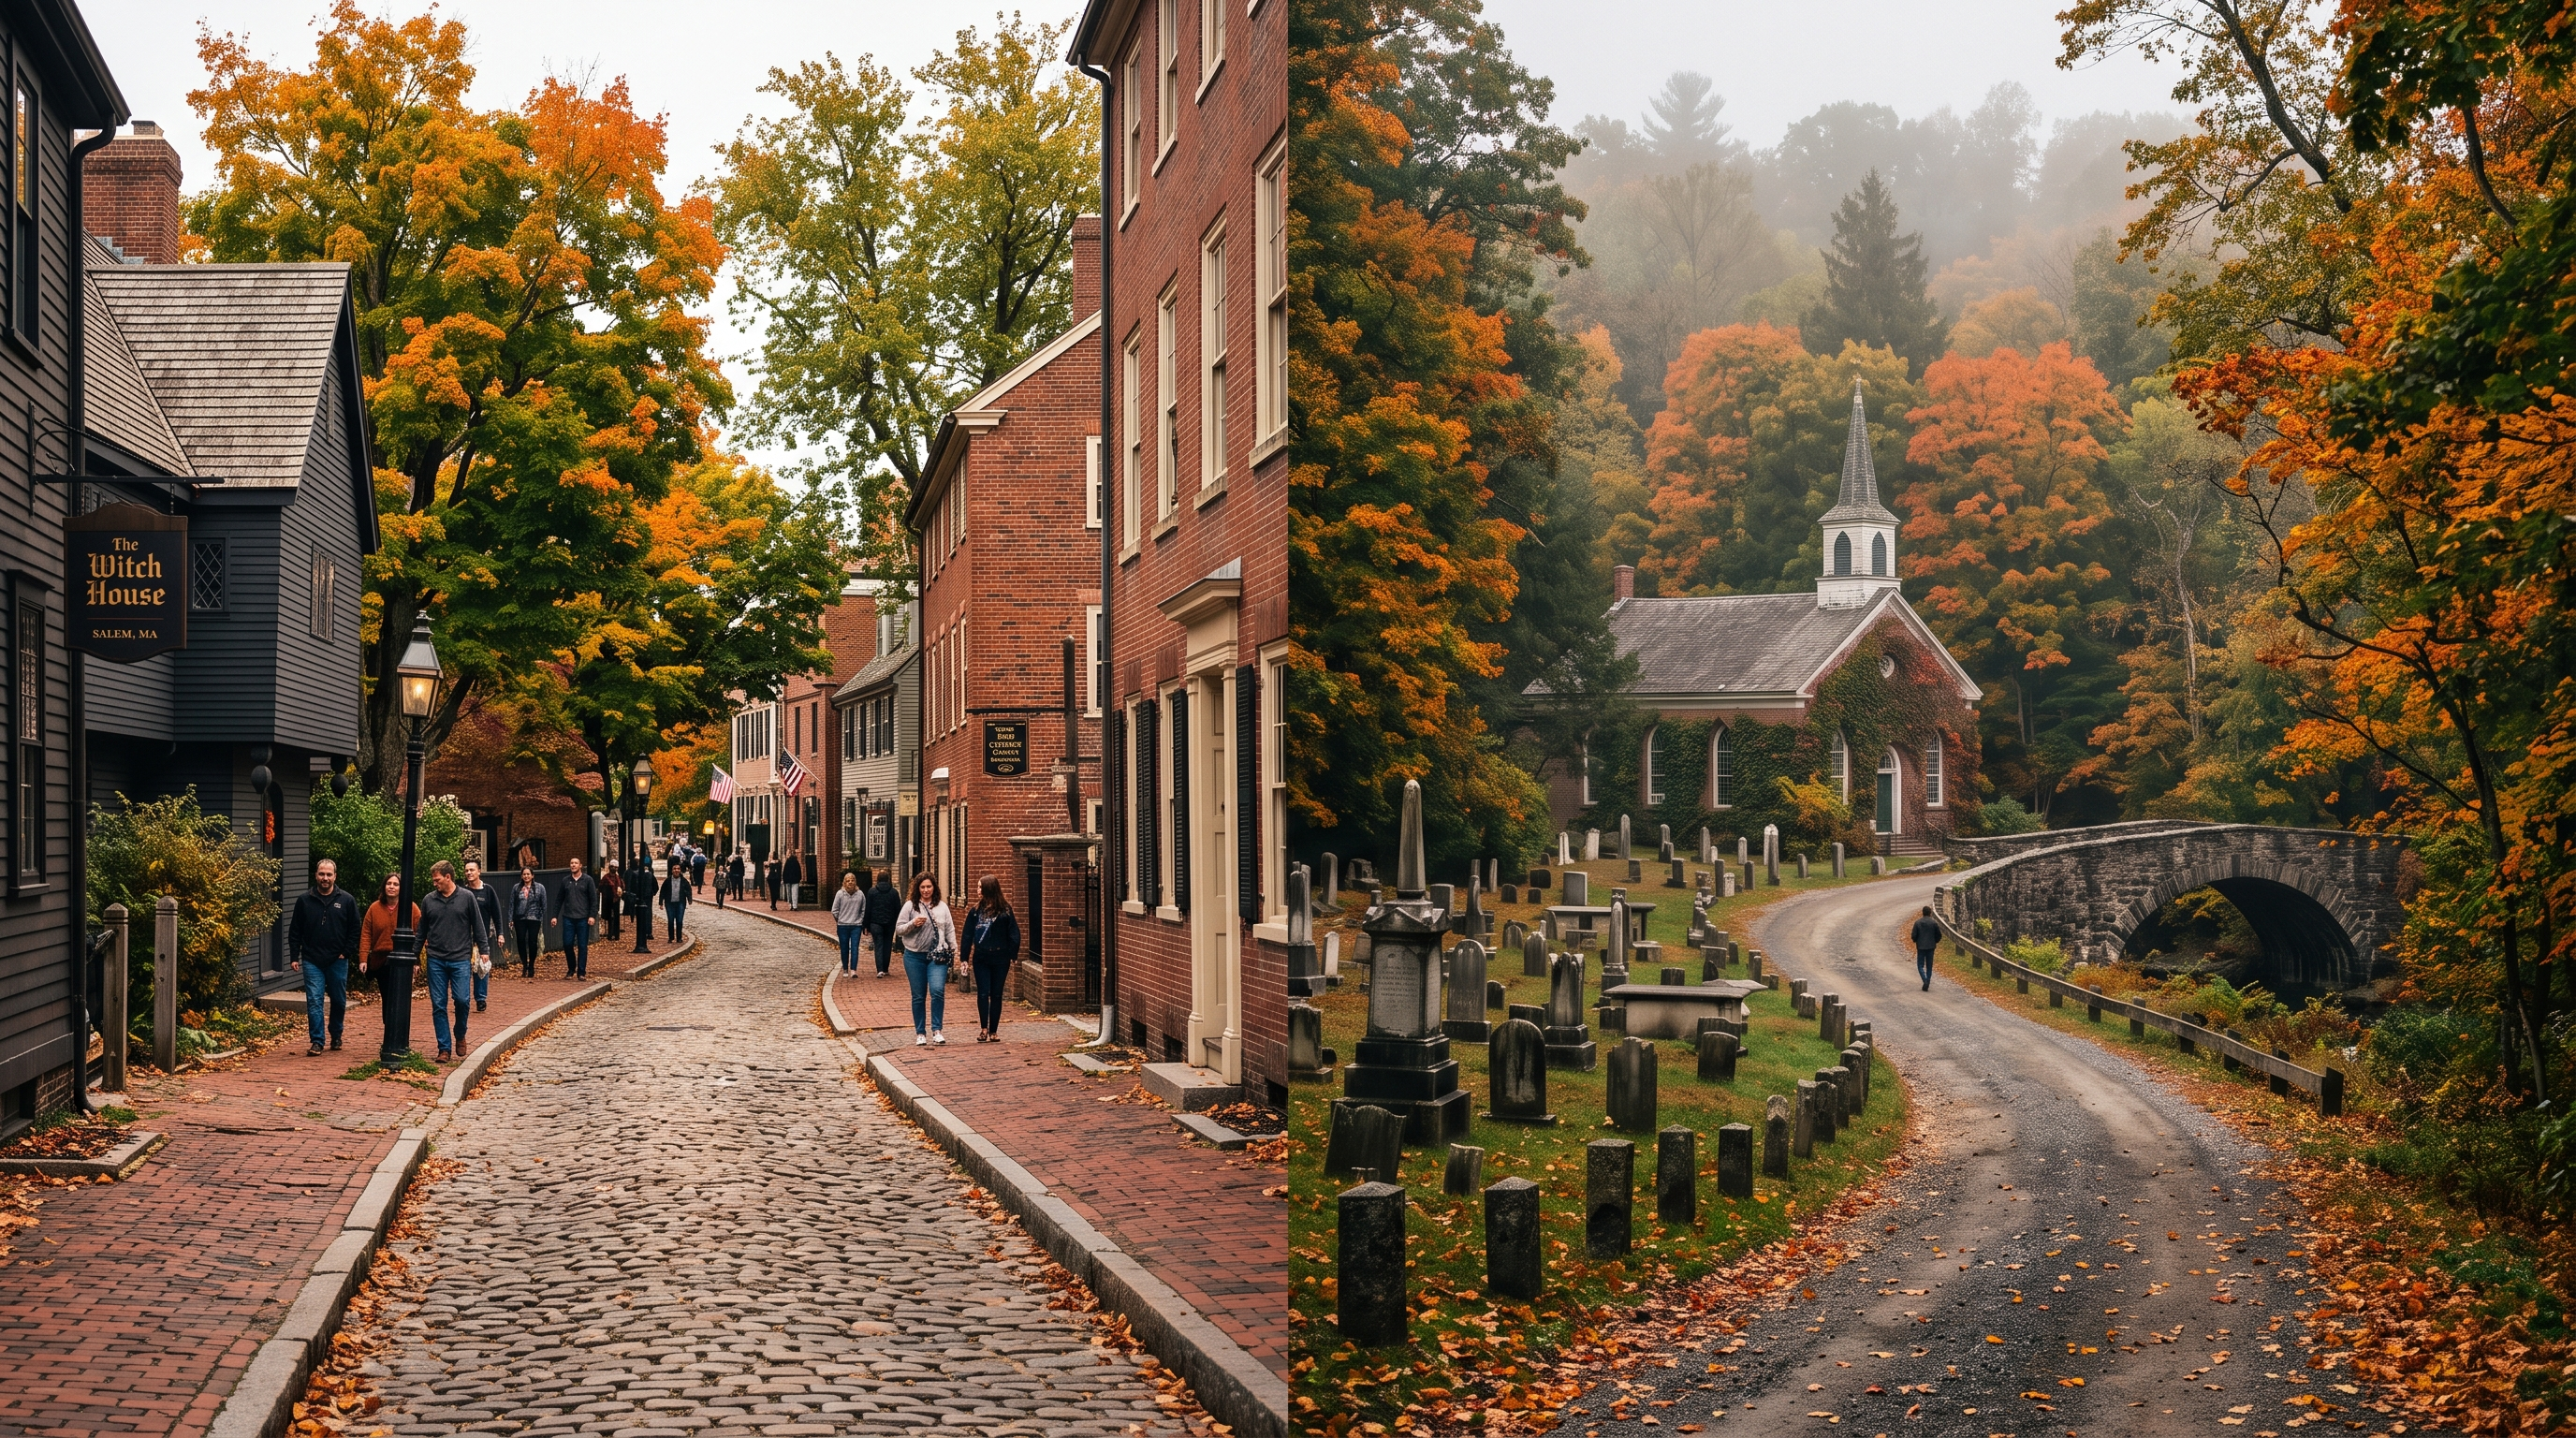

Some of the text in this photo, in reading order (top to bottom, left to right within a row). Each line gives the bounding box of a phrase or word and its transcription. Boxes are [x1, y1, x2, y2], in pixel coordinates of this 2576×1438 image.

[112, 537, 139, 551] The
[87, 552, 162, 578] Witch
[86, 580, 166, 606] House
[93, 629, 158, 639] SALEM, MA
